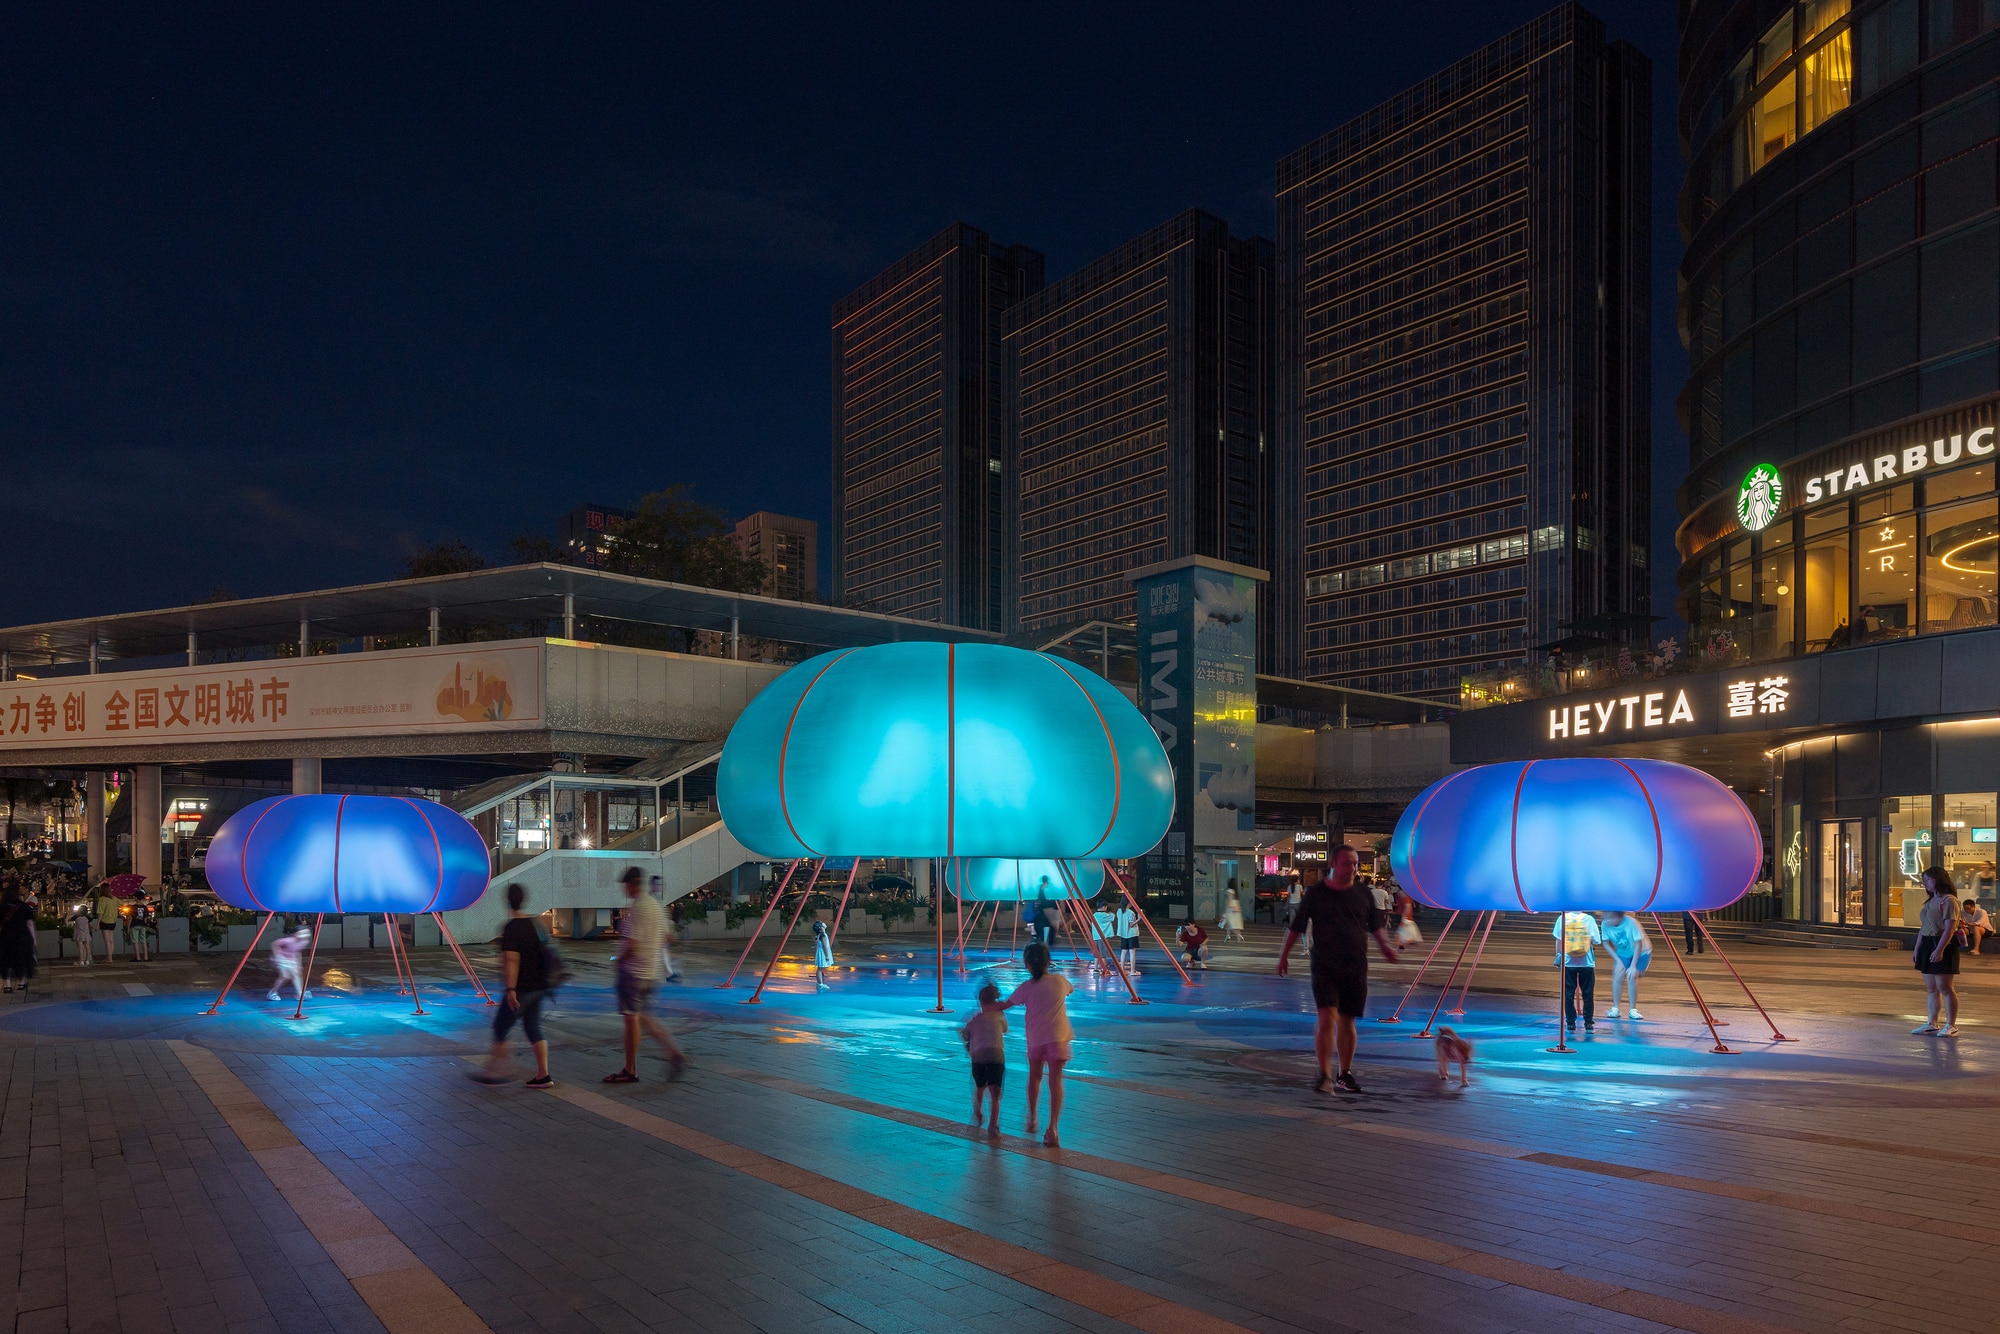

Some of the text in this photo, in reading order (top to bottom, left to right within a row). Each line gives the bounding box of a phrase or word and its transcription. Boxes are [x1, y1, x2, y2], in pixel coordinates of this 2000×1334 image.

[1881, 555, 1895, 572] R
[0, 676, 290, 736] 力争创 全国文明城市
[1196, 667, 1244, 686] 公共城事节
[1150, 629, 1178, 812] IMA
[1549, 676, 1789, 740] HEYTEA 喜茶
